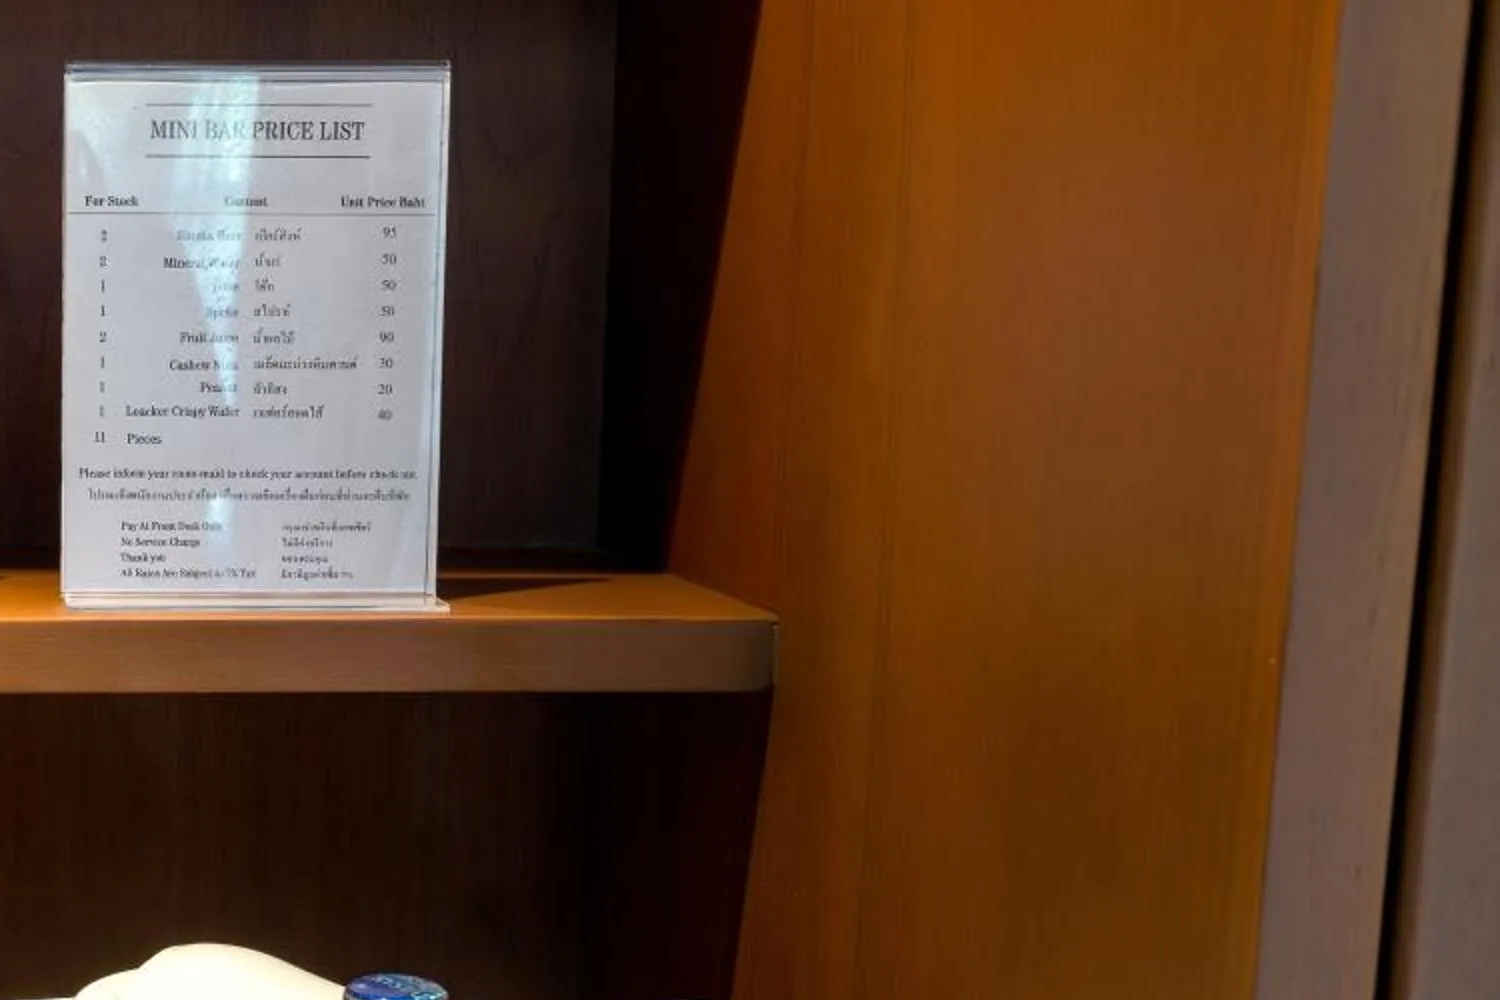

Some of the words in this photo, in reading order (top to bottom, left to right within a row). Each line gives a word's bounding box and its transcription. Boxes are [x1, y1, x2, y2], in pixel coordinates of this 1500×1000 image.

[149, 120, 197, 141] MINI
[204, 120, 248, 141] BAR
[253, 120, 314, 141] PRICE
[319, 120, 366, 141] LIST
[368, 195, 396, 208] Price
